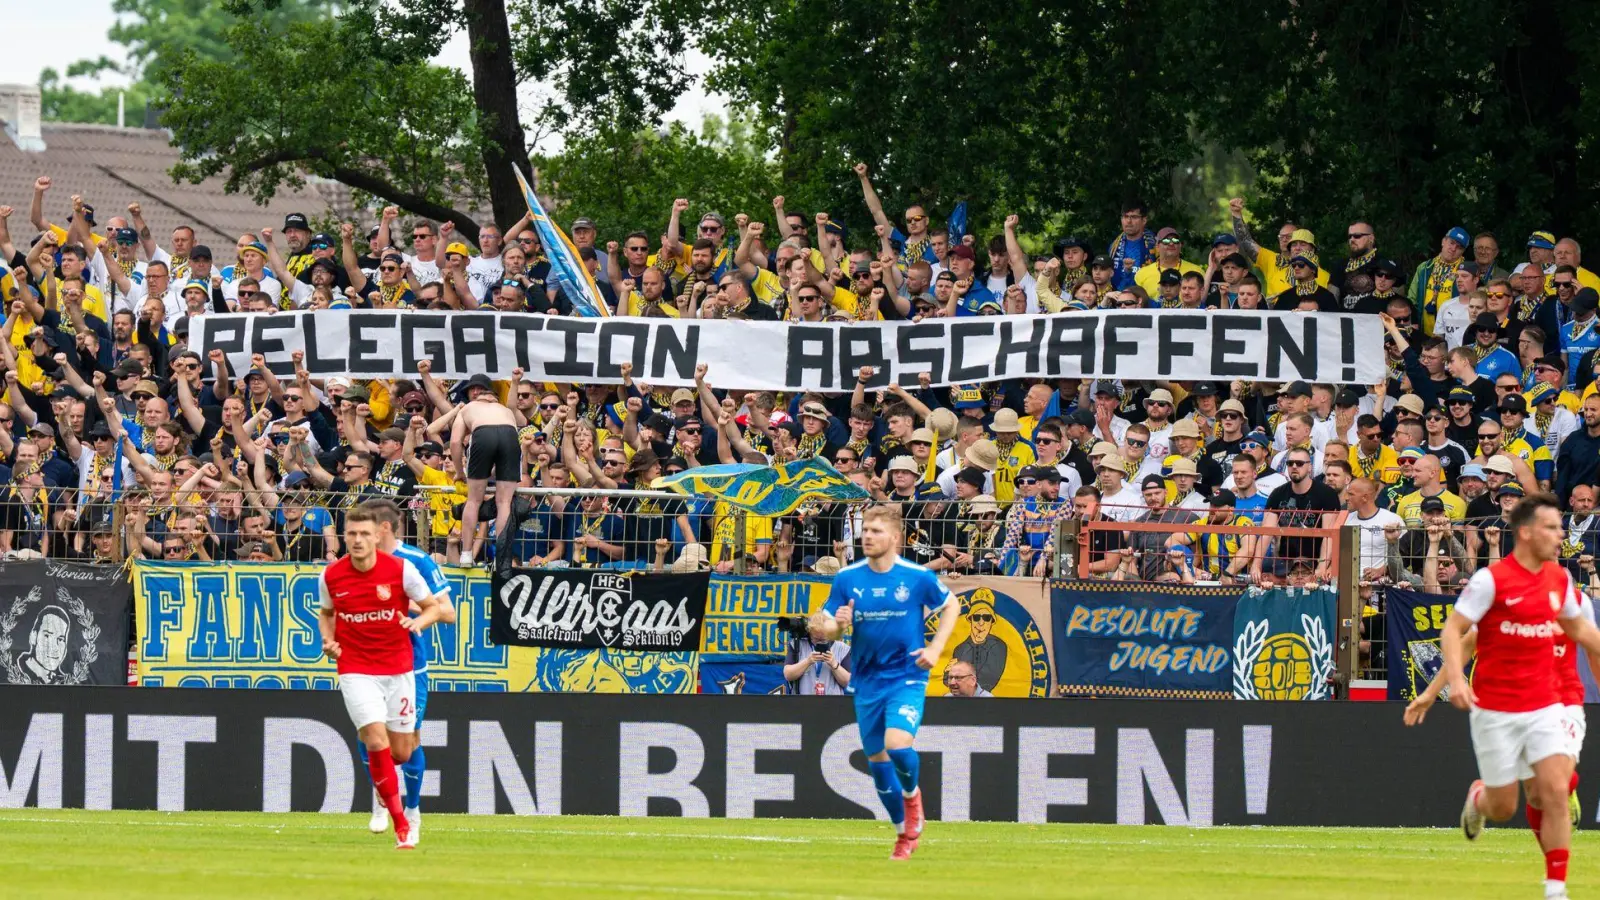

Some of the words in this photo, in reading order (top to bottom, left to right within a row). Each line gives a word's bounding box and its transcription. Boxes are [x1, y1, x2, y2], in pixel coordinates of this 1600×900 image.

[202, 312, 701, 380] RELEGATION
[785, 314, 1356, 390] ABSCHAFFEN!
[45, 562, 94, 582] Florian
[597, 575, 625, 590] HFC
[709, 582, 781, 614] TIFOSI
[786, 584, 811, 615] IN
[140, 570, 509, 669] FANSNE
[517, 622, 584, 642] Saalefront
[1065, 604, 1204, 640] RESOLUTE
[622, 628, 669, 647] Sektion
[704, 620, 790, 653] PENSIO
[1108, 641, 1230, 676] JUGEND
[0, 712, 217, 811] MIT
[619, 721, 1273, 827] BESTEN!
